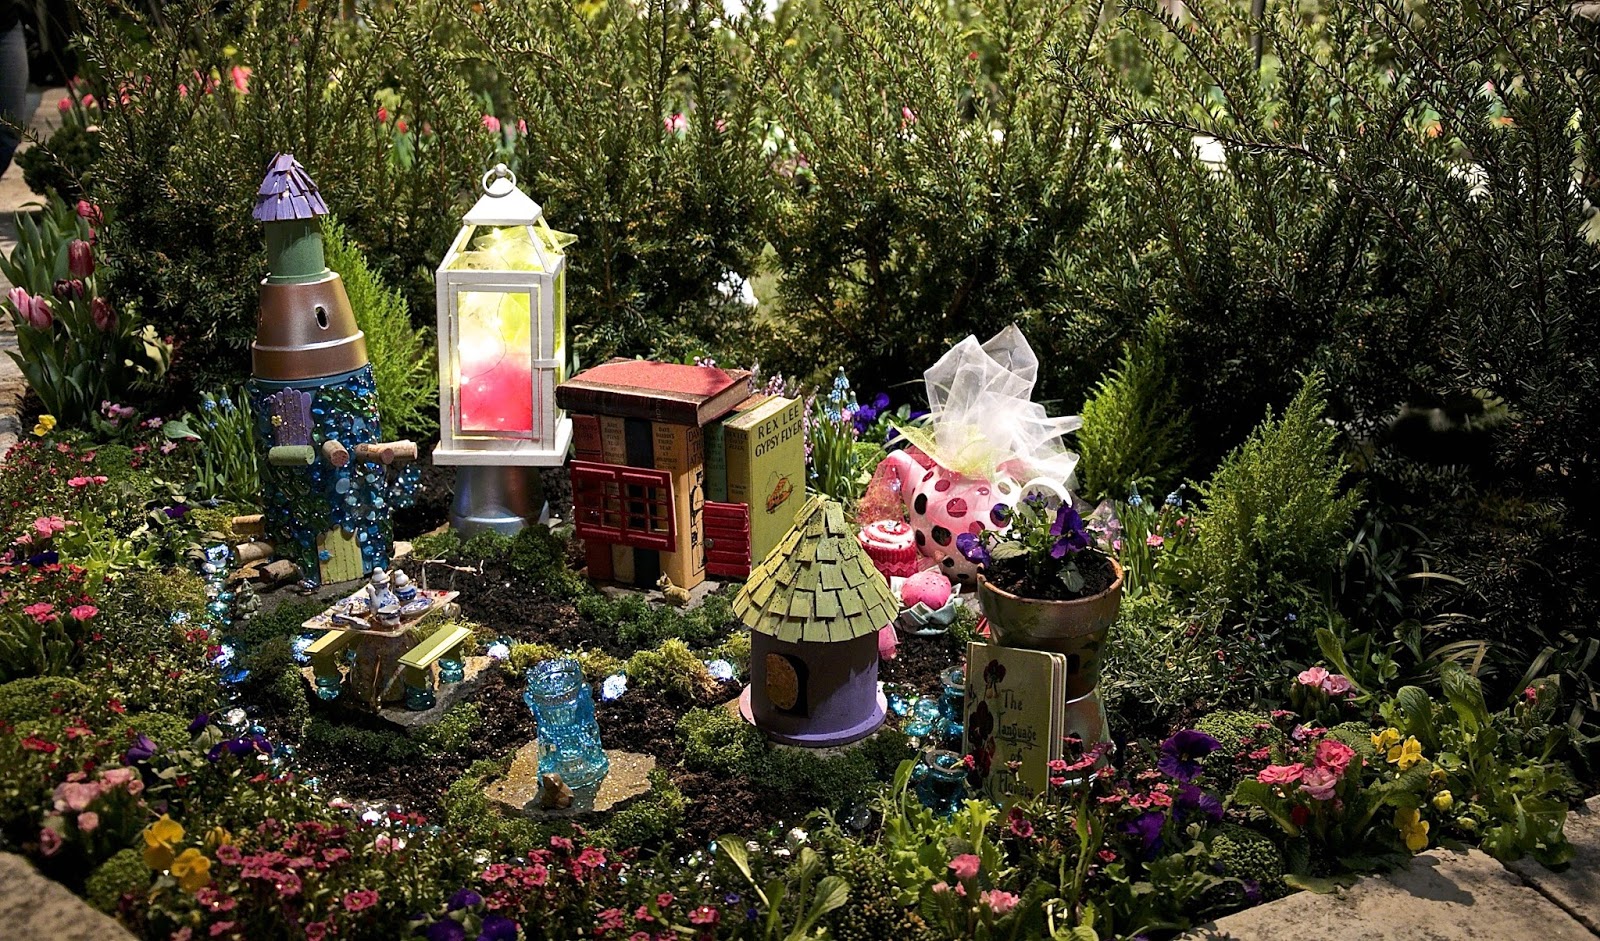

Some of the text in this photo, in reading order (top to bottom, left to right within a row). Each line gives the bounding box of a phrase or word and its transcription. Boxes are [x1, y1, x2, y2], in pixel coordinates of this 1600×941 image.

[758, 404, 799, 439] REX LEE
[755, 419, 802, 457] GYPSY FLYER
[1001, 689, 1023, 711] The
[995, 711, 1037, 741] Language
